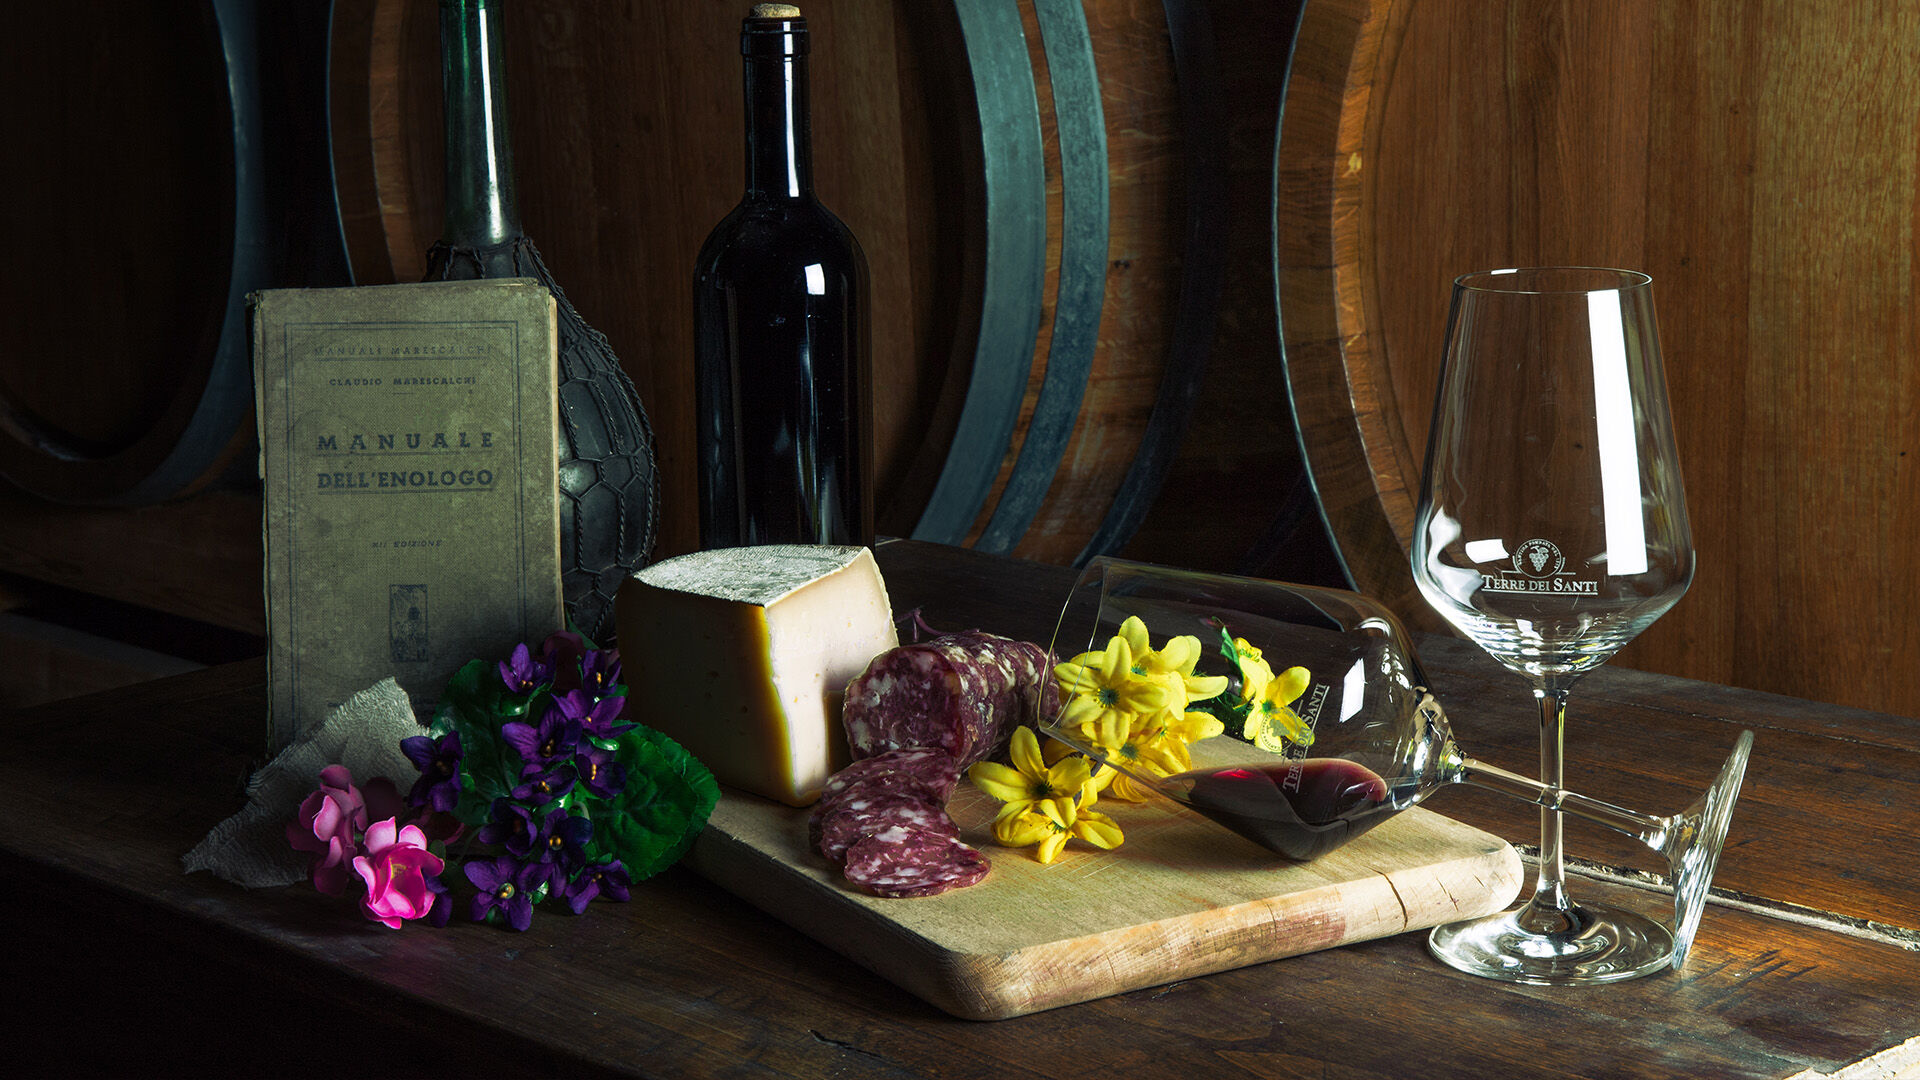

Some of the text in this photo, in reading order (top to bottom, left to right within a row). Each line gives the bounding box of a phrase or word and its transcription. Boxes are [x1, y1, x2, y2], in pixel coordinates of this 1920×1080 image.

[329, 376, 477, 386] CLAUDIO MARESCALCHI
[317, 432, 493, 451] MANUALE
[317, 469, 494, 489] DELL'ENOLOGO
[393, 540, 443, 548] EDIZIONE
[1481, 574, 1599, 593] TERRE DEI SANTI
[1301, 682, 1327, 726] SANTI
